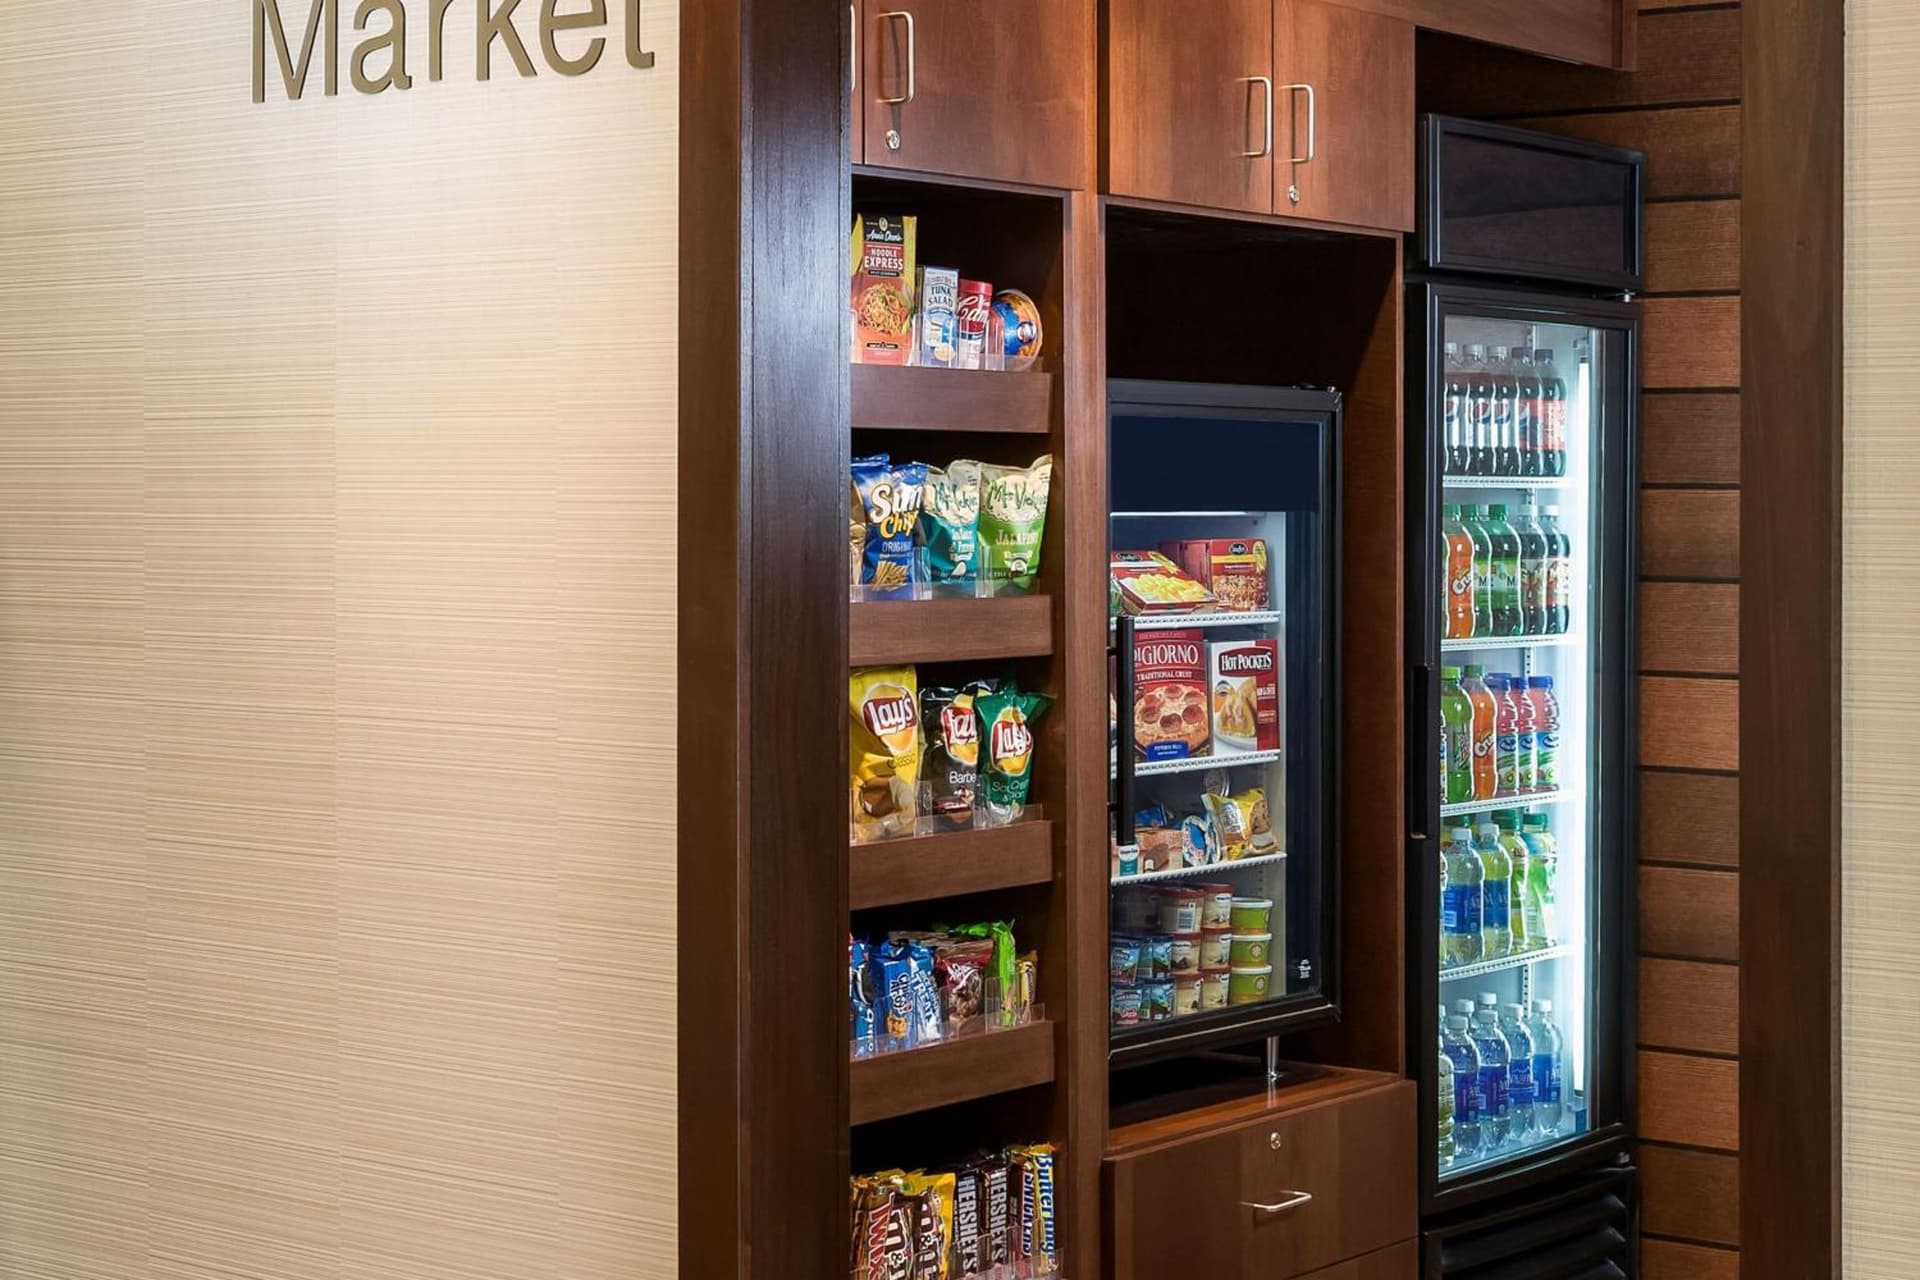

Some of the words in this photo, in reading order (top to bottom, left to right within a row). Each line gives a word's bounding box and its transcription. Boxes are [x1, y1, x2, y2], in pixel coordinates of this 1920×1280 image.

[251, 0, 657, 103] Market
[864, 256, 903, 270] EXPRESS
[928, 295, 953, 307] SALAD
[931, 285, 952, 297] TUNA
[870, 484, 923, 523] Sun
[1221, 655, 1237, 671] HOT
[1237, 653, 1272, 670] POCKETS
[868, 697, 913, 736] Lay's
[957, 1173, 978, 1275] HERSHEY'S
[989, 1166, 1008, 1264] HERSHEY'S
